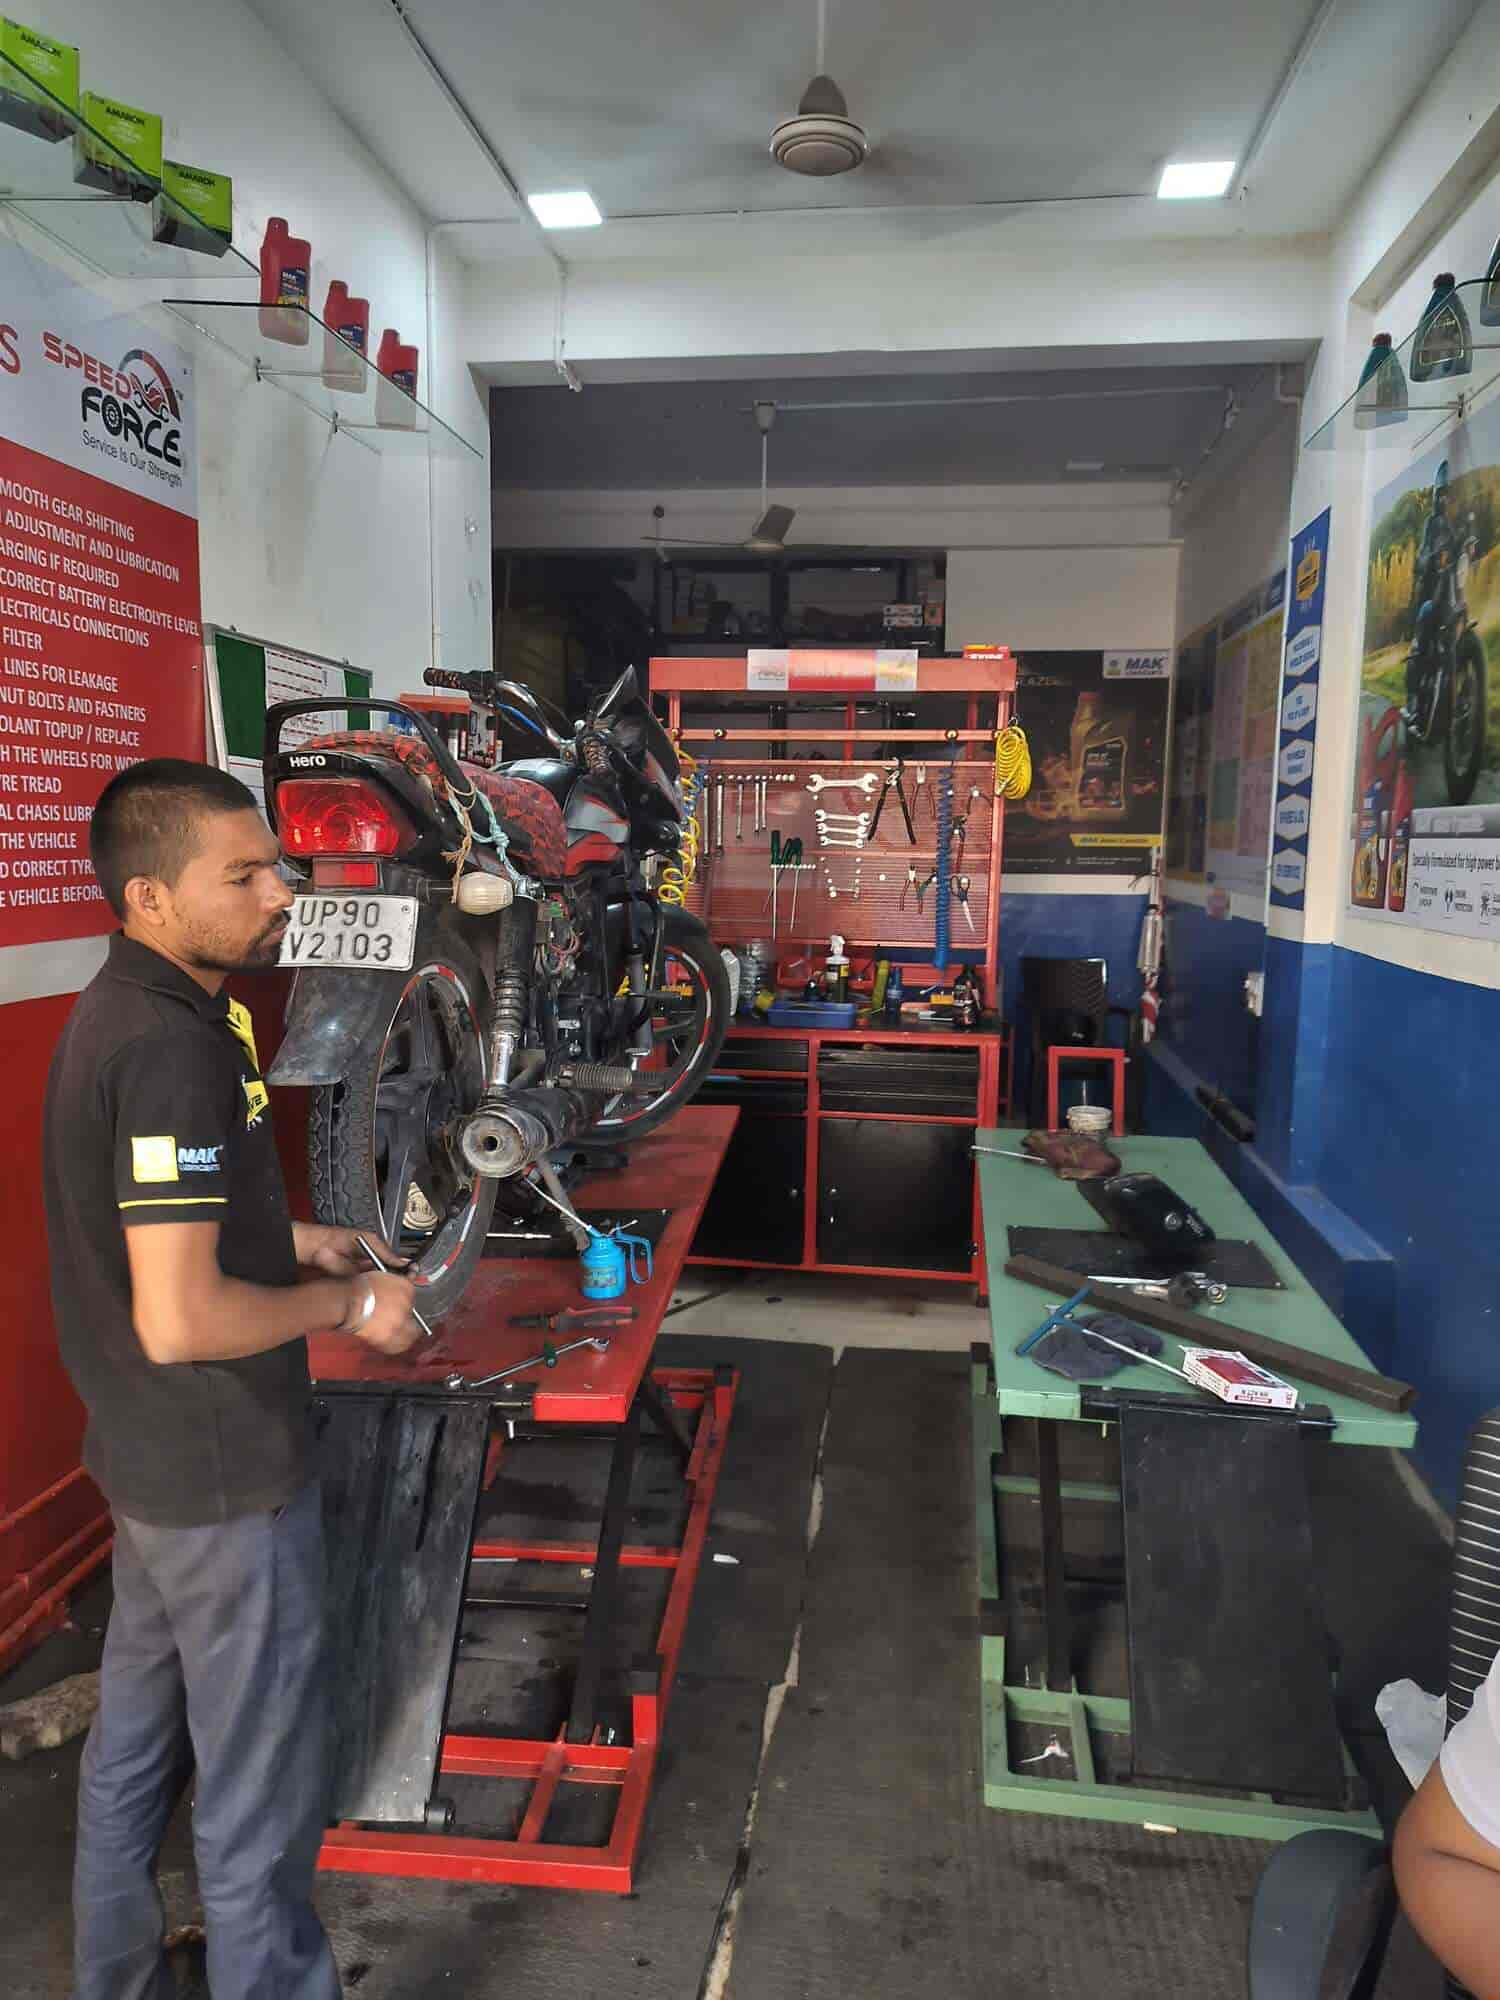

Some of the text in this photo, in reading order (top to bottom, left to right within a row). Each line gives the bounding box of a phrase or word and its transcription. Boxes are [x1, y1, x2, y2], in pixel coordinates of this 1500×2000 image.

[43, 331, 132, 400] SPEED
[81, 386, 182, 467] FORCE
[82, 430, 182, 488] Service Is Our Strength
[0, 477, 135, 542] MOOTH GEAR SHIFTING
[5, 509, 180, 583] ADJUSTMENT AND LUBRICATION
[49, 552, 61, 571] IF
[63, 556, 119, 589] REQUIRED
[0, 567, 200, 636] CORRECT BATTERY ELECTROLYTE LEVEL
[0, 597, 149, 647] LECTRICALS CONNECTIONS
[3, 626, 43, 651] FILTER
[4, 656, 118, 693] LINES FOR LEAKAGE
[1125, 656, 1164, 670] MAK
[0, 686, 146, 722] NUT BOLTS AND FASTNERS
[0, 715, 140, 747] OLANT TOPUP / REPLACE
[14, 745, 38, 764] THE
[40, 748, 88, 768] WHEELS
[90, 753, 112, 770] FOR
[289, 755, 326, 768] Hero
[20, 774, 62, 794] TREAD
[16, 803, 60, 821] CHASIS
[63, 805, 95, 822] LUBR
[2, 832, 77, 849] THE VEHICLE
[13, 859, 67, 878] CORRECT
[71, 859, 96, 875] TYR
[9, 887, 59, 907] VEHICLE
[299, 900, 381, 928] UP90
[289, 932, 393, 961] V2103
[178, 1147, 217, 1163] MAK
